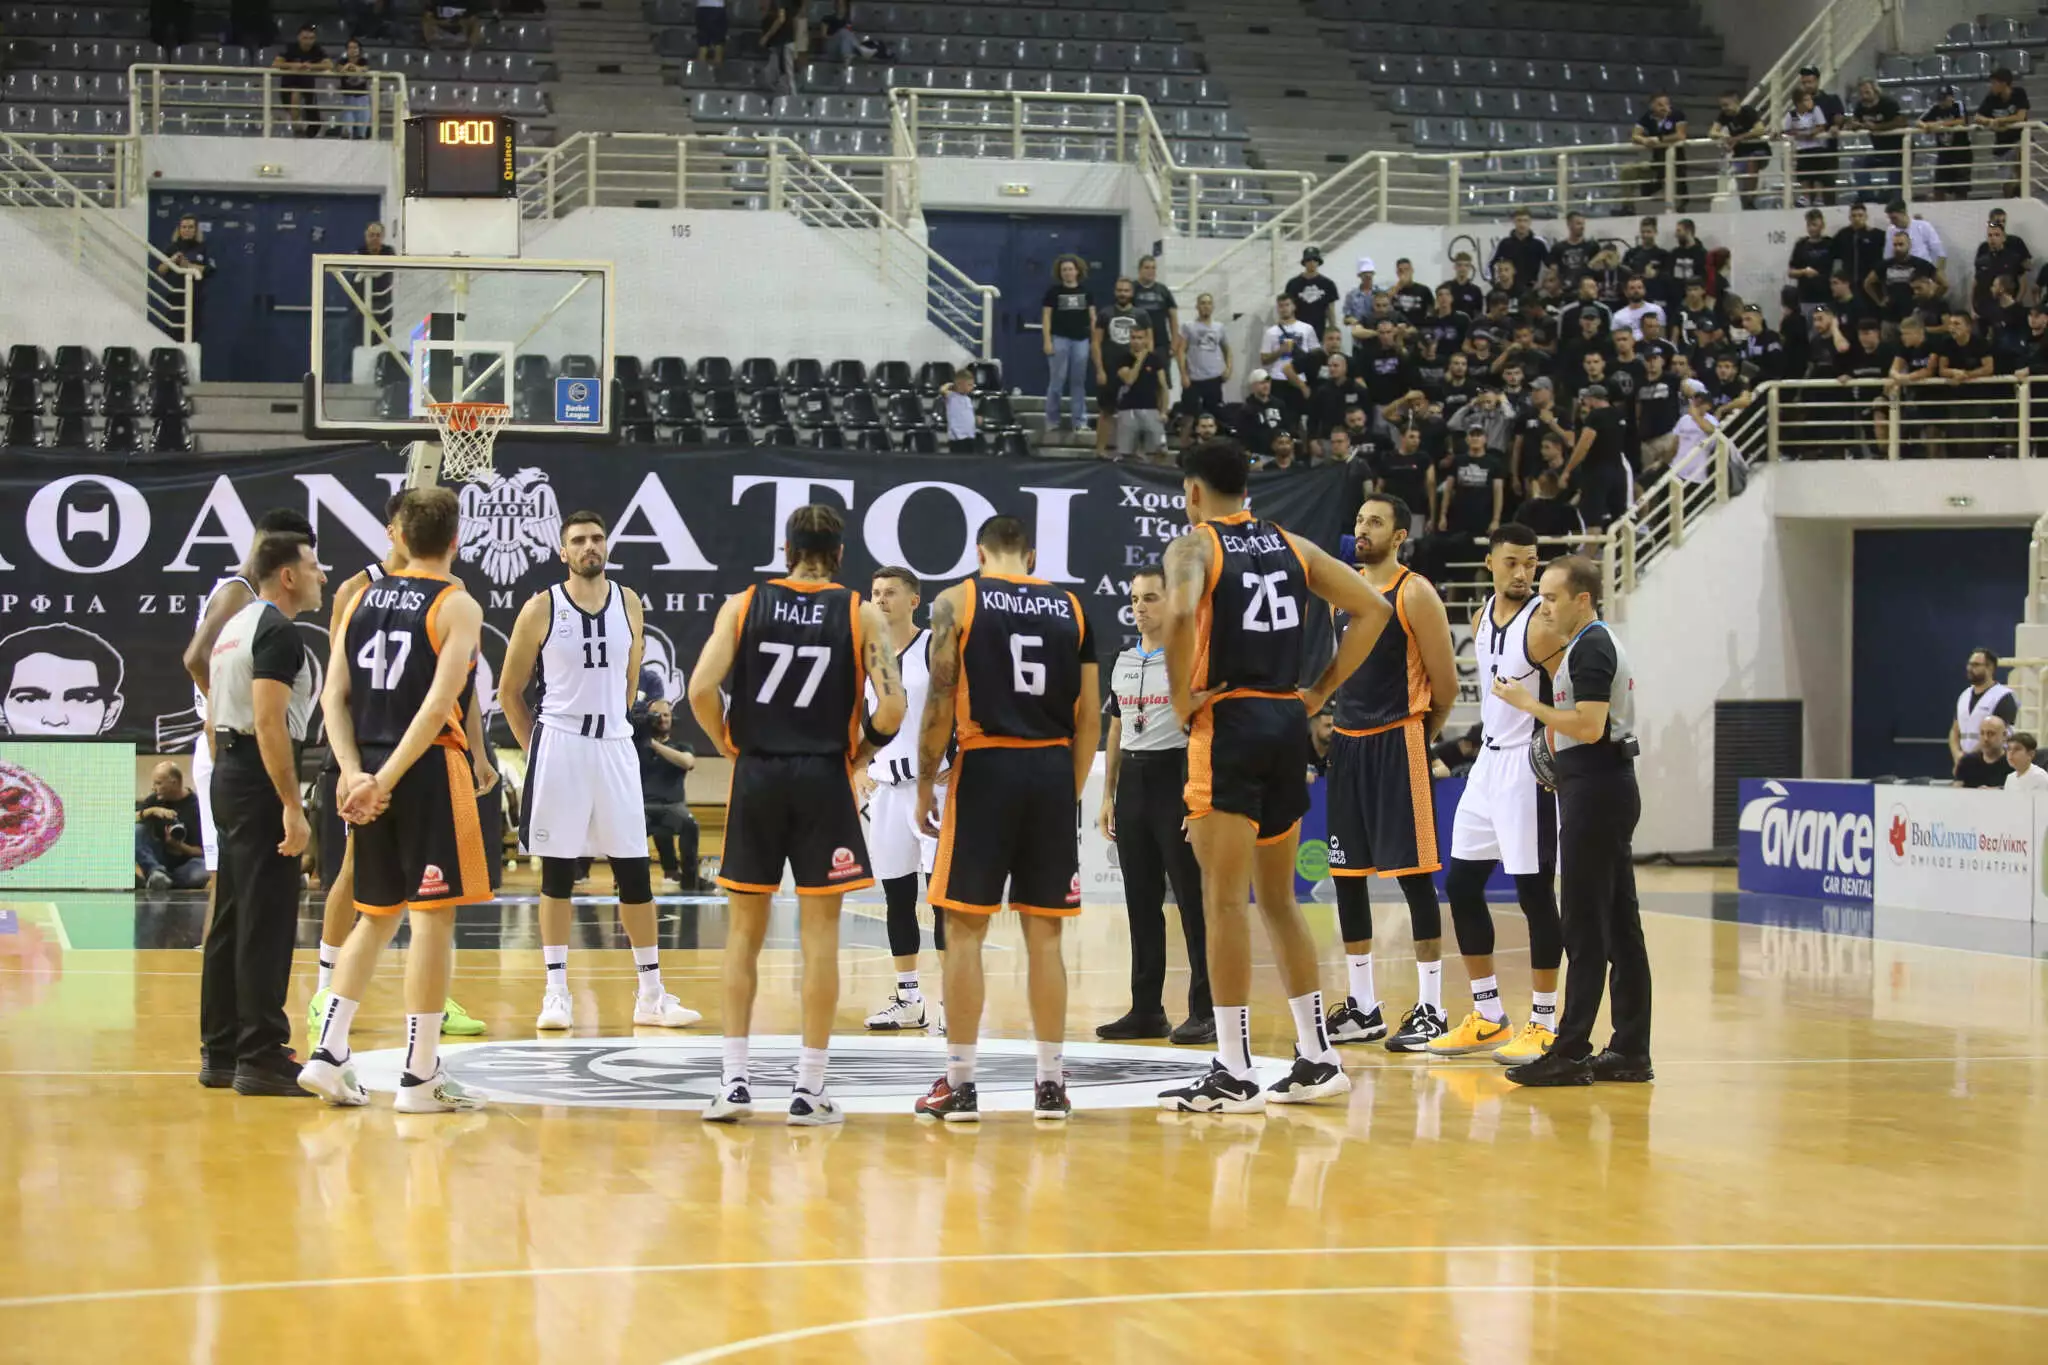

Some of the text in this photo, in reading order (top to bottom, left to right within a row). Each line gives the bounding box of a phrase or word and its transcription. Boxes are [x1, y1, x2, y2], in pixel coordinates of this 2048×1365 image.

[440, 121, 494, 144] 10:00
[671, 224, 691, 238] 105
[1767, 230, 1786, 244] 106
[479, 503, 535, 516] ΠΑΟΚ
[774, 601, 825, 625] HALE
[982, 591, 1071, 619] ΚΟΝΙΑΡΗΣ
[1242, 570, 1300, 632] 26
[357, 629, 412, 690] 47
[583, 642, 608, 668] 11
[1010, 633, 1046, 696] 6
[756, 641, 831, 708] 77
[1761, 806, 1874, 876] avance
[1823, 875, 1873, 898] CAR RENTAL
